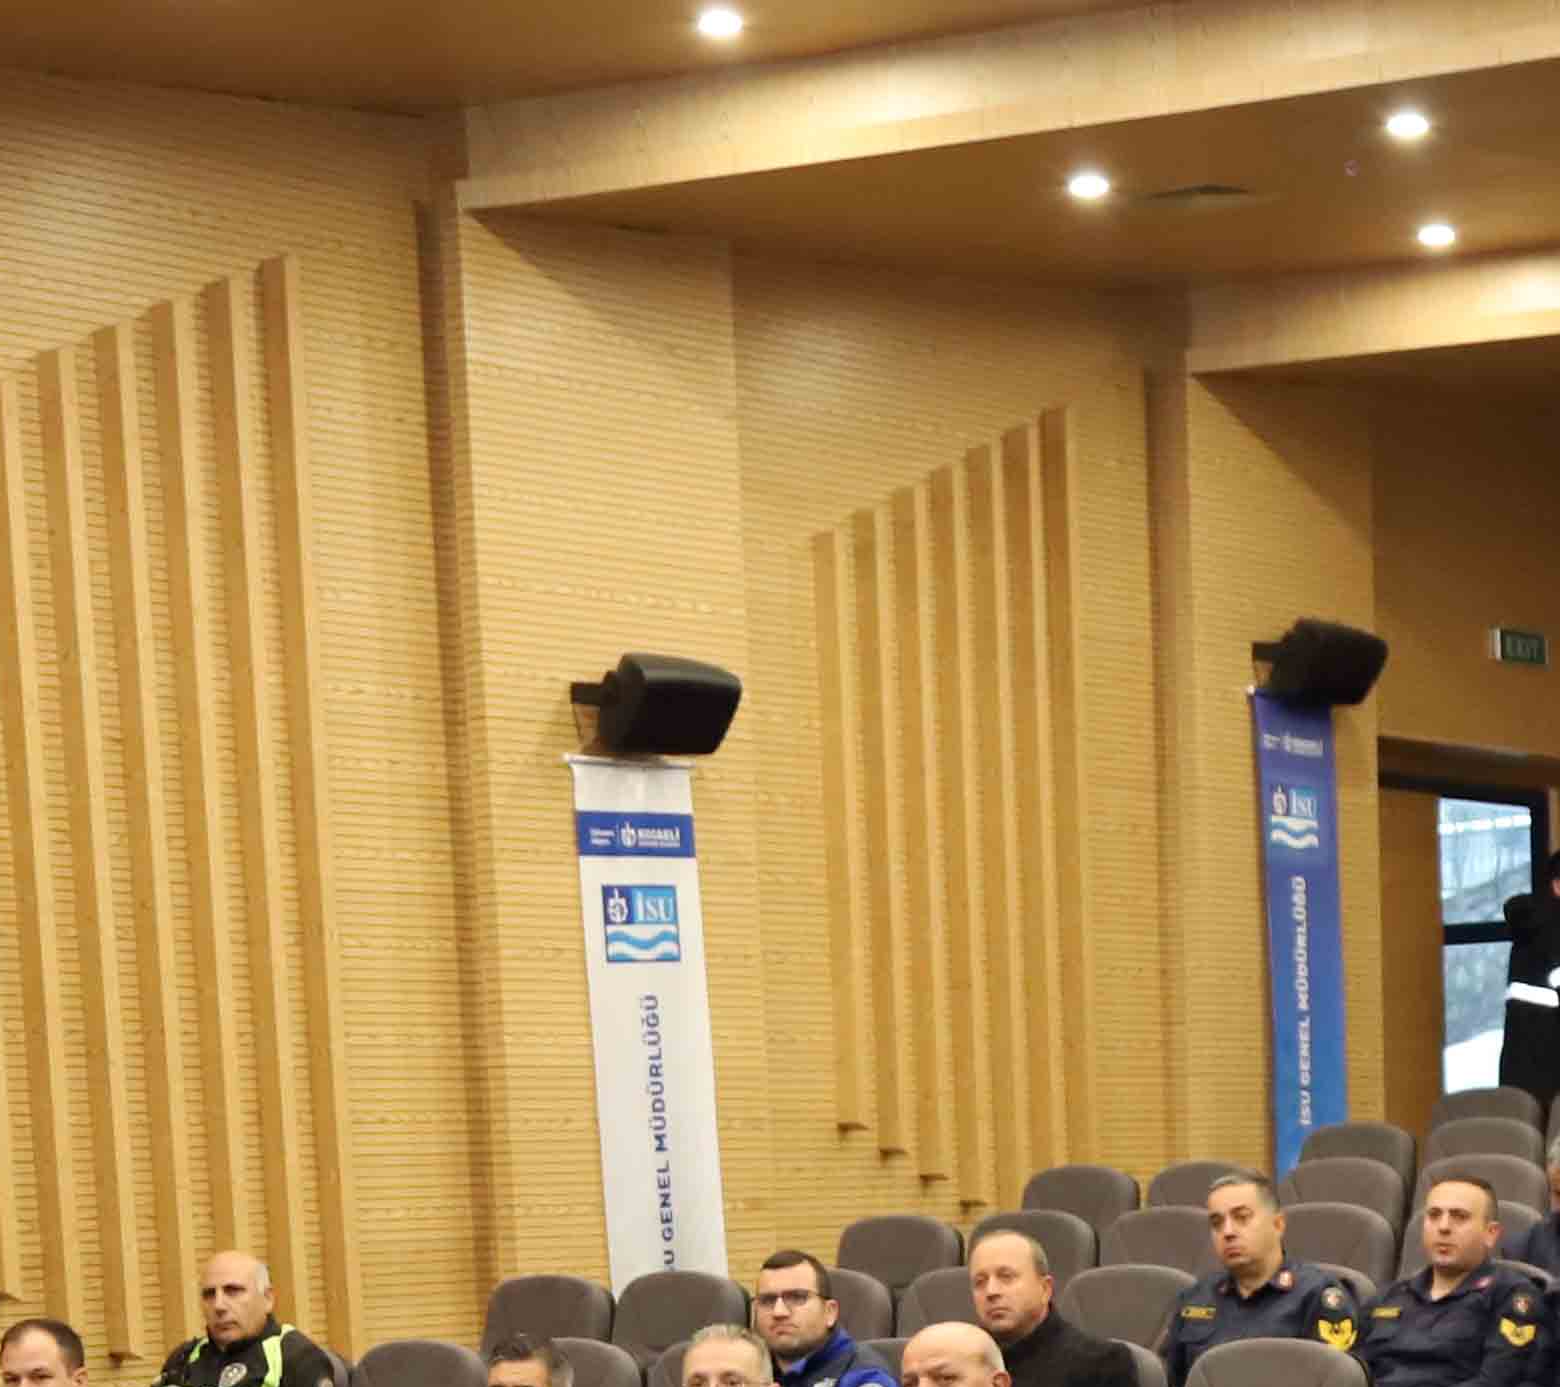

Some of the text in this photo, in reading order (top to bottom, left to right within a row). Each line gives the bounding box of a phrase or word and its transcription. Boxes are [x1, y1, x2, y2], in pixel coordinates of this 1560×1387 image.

[633, 889, 674, 921] İSU
[639, 994, 669, 1153] MÜDÜRLÜĞÜ
[655, 1159, 675, 1242] GENEL
